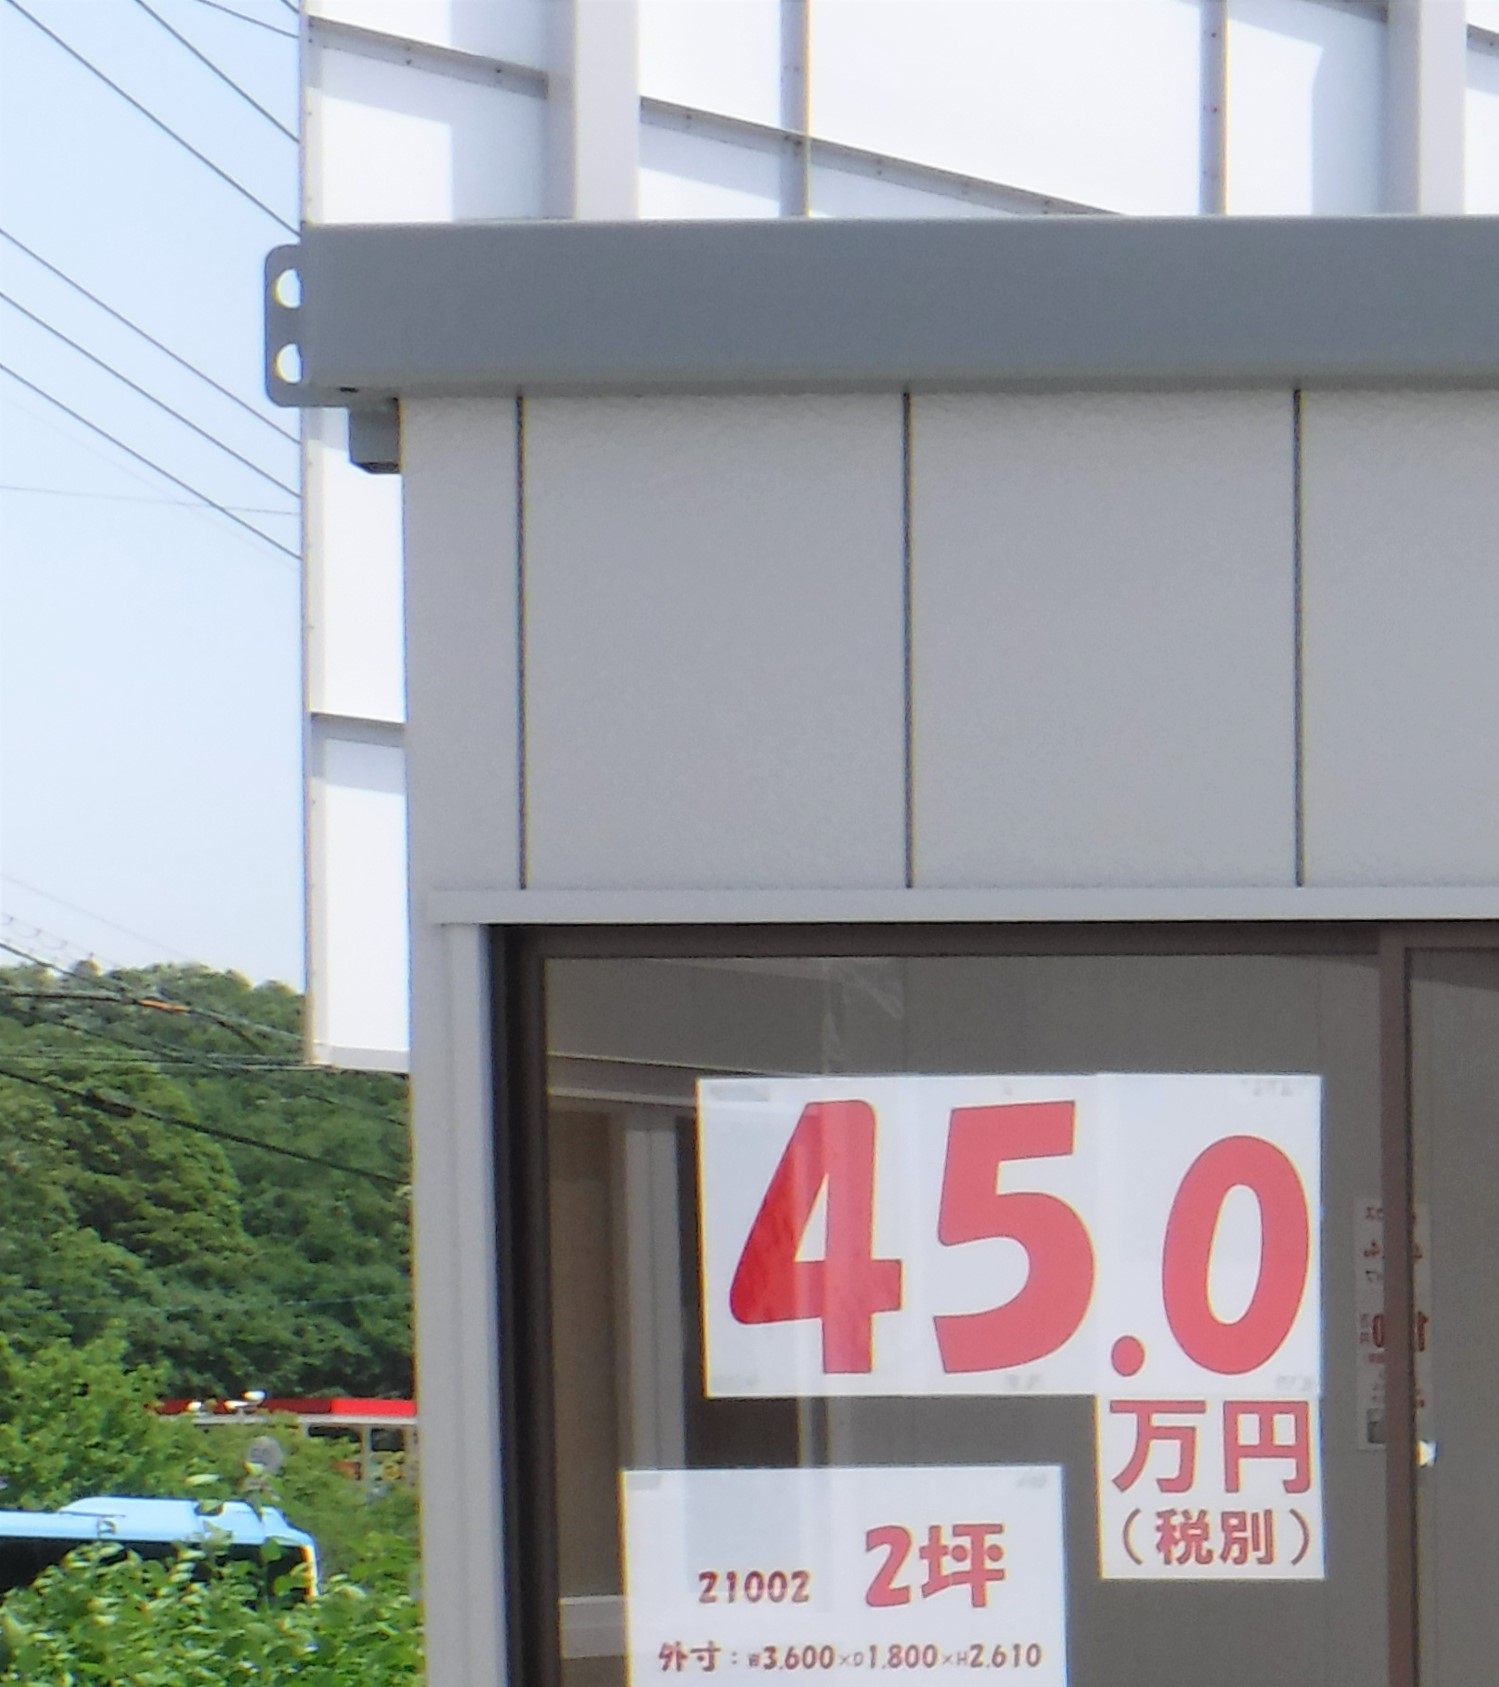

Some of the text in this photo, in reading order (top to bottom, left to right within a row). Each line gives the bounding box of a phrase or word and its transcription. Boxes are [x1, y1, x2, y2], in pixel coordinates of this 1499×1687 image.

[729, 1098, 1310, 1378] 45.0
[1109, 1400, 1311, 1494] 万円
[697, 1523, 1006, 1608] 21002 2坪
[1122, 1507, 1310, 1566] （税別）
